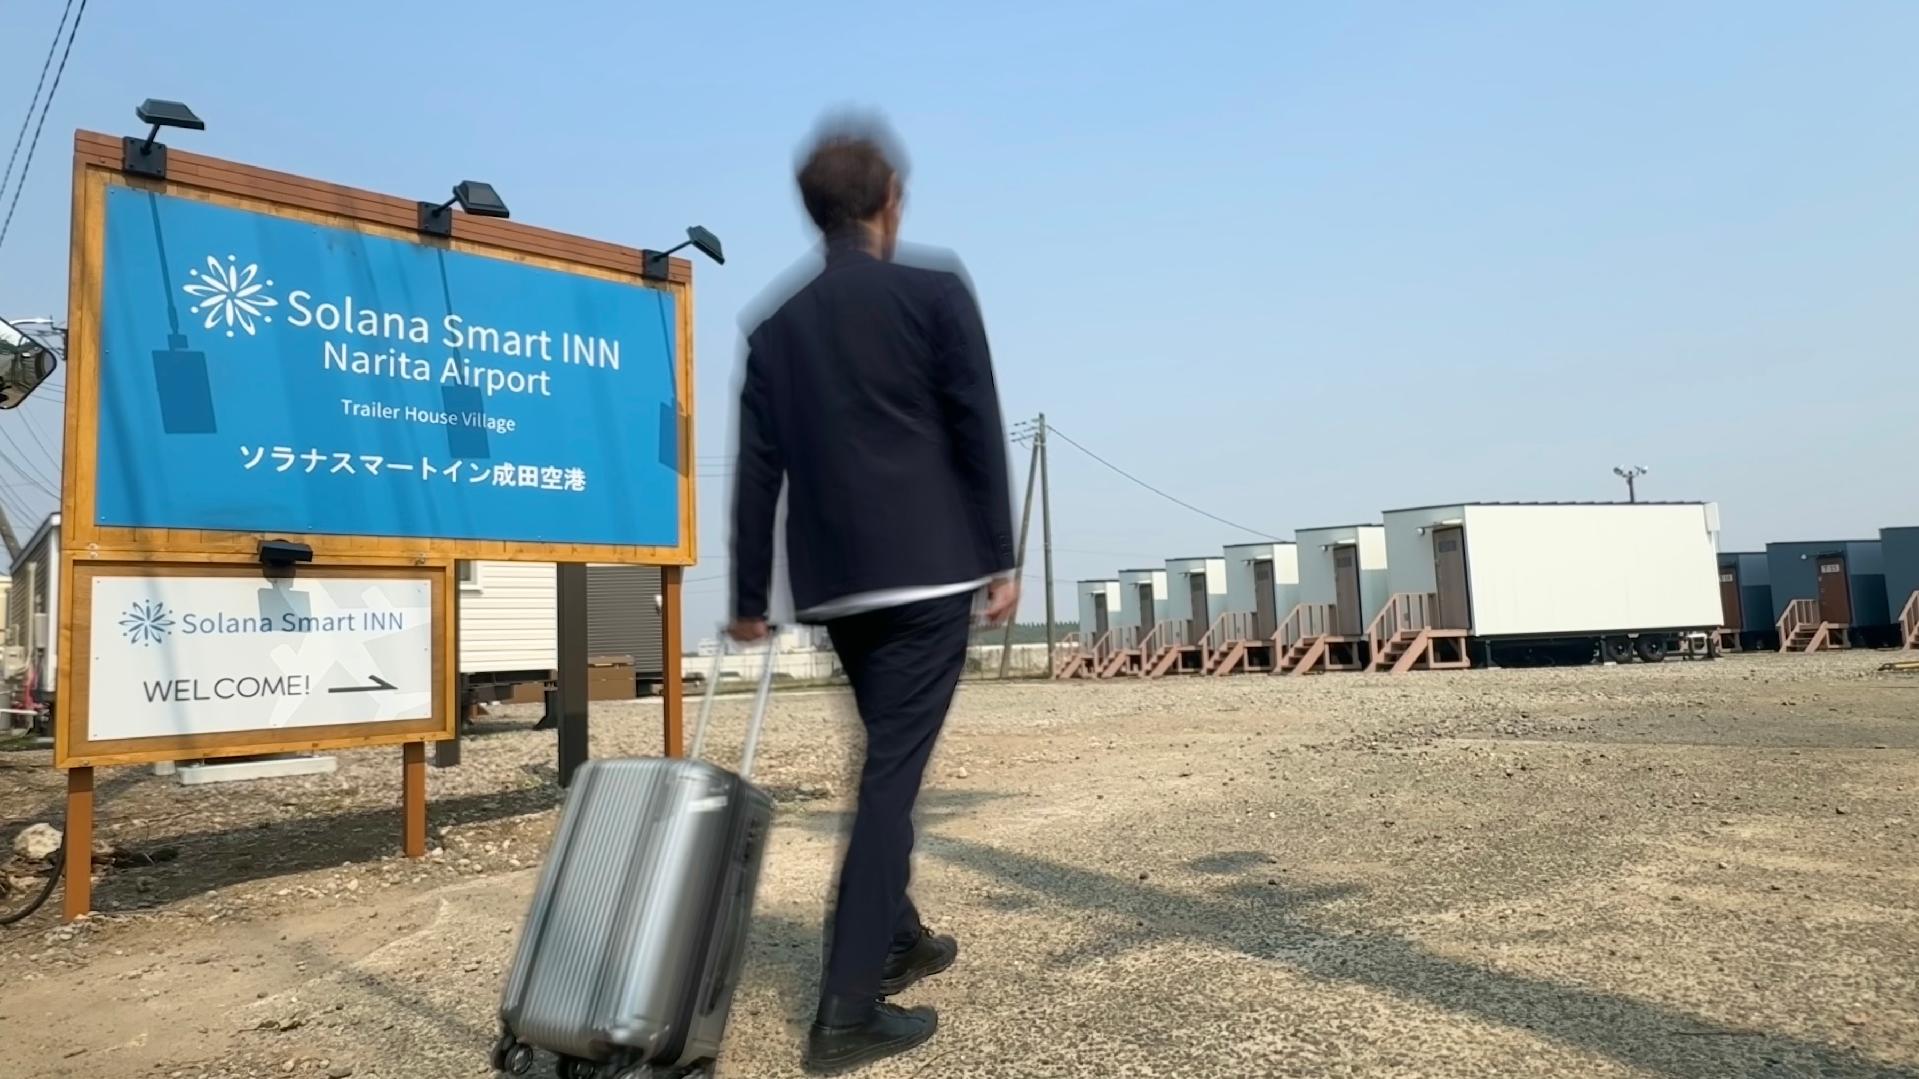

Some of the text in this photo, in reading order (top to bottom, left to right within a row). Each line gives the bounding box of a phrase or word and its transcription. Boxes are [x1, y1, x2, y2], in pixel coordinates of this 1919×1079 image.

[287, 290, 621, 371] Solana Smart INN
[323, 340, 552, 397] Narita Airport
[341, 399, 517, 434] Trailer House Village
[239, 444, 587, 493] ソラナスマートイン成田空港
[182, 611, 404, 635] Solana Smart INN
[142, 674, 311, 703] WELCOME!
